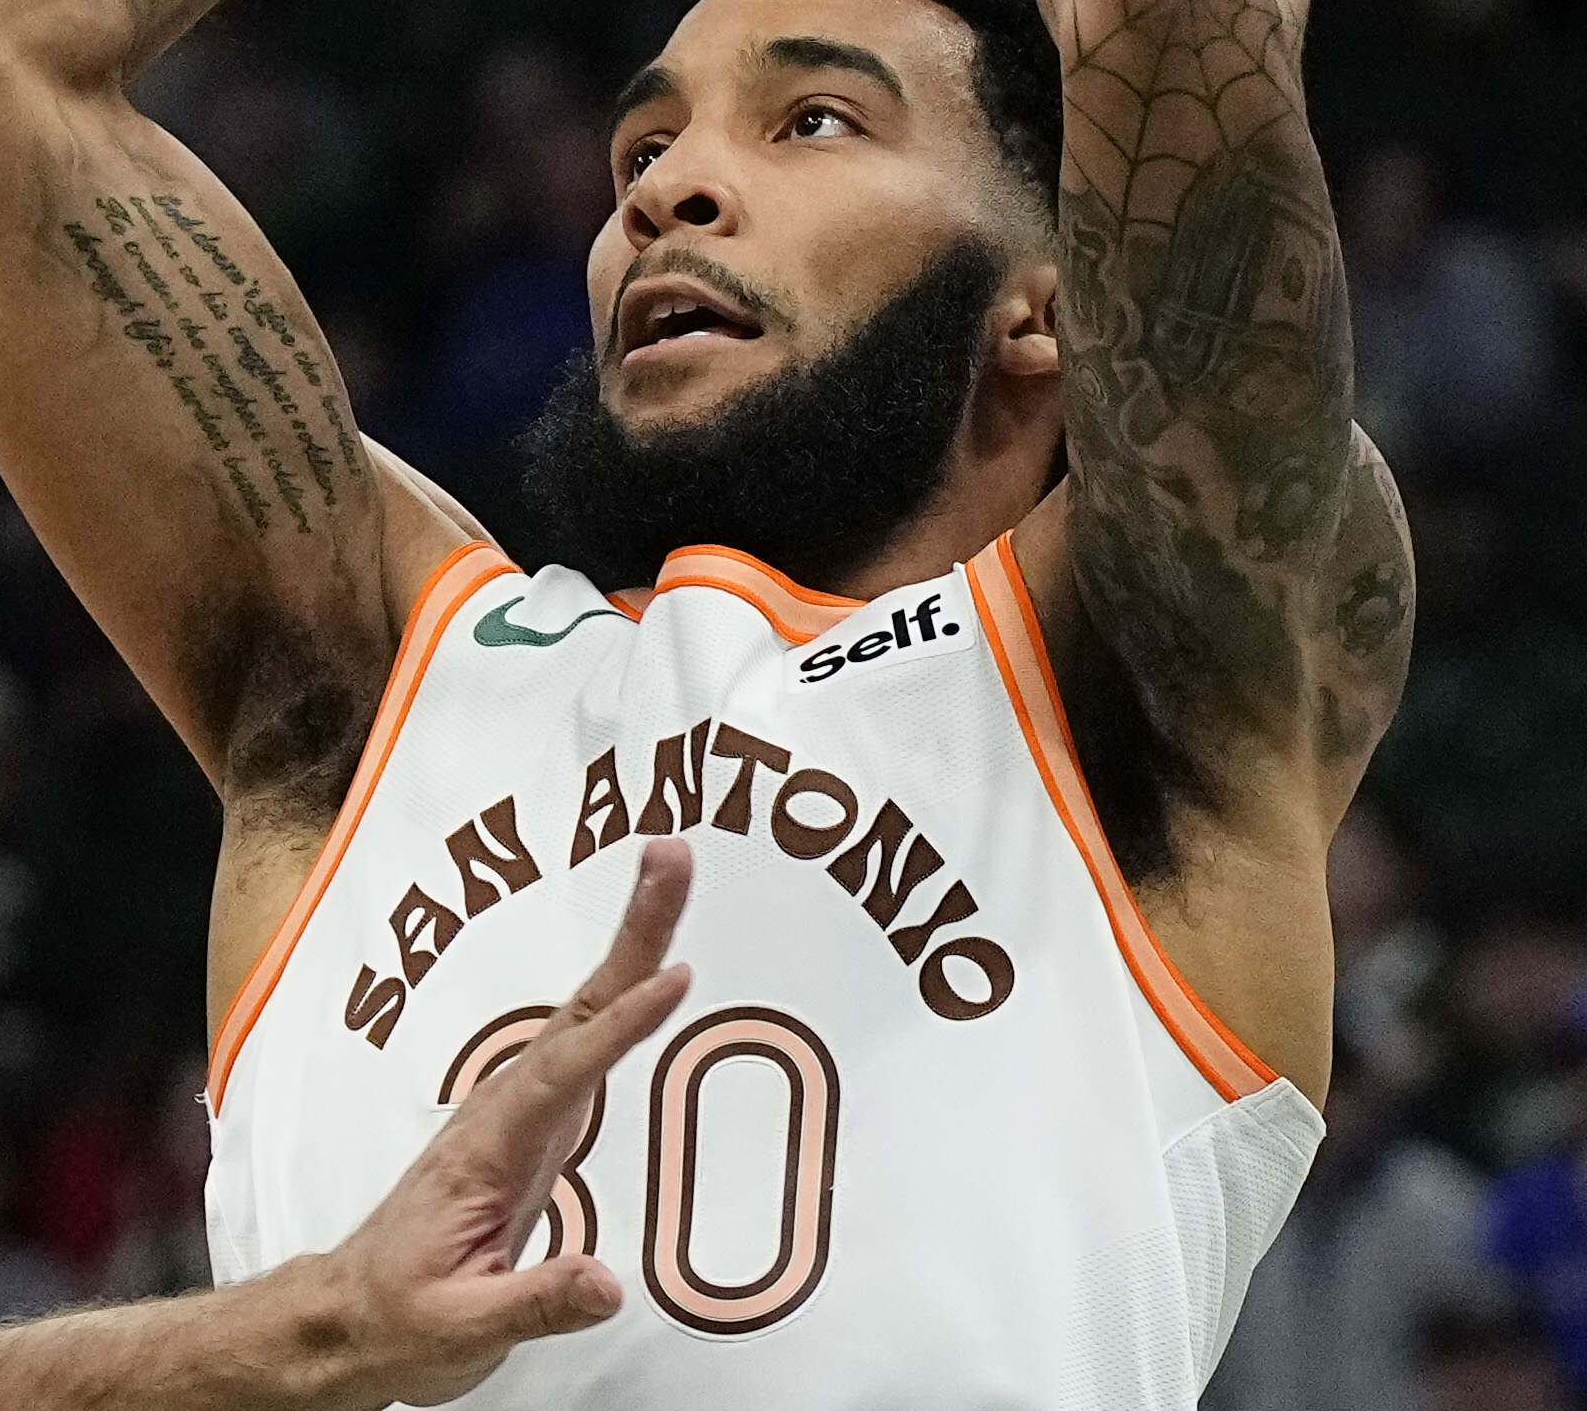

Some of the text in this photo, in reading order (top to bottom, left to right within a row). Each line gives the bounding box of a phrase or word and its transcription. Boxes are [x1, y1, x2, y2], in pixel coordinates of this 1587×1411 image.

[199, 292, 228, 321] his
[345, 718, 1014, 1050] SAN ANTONIO
